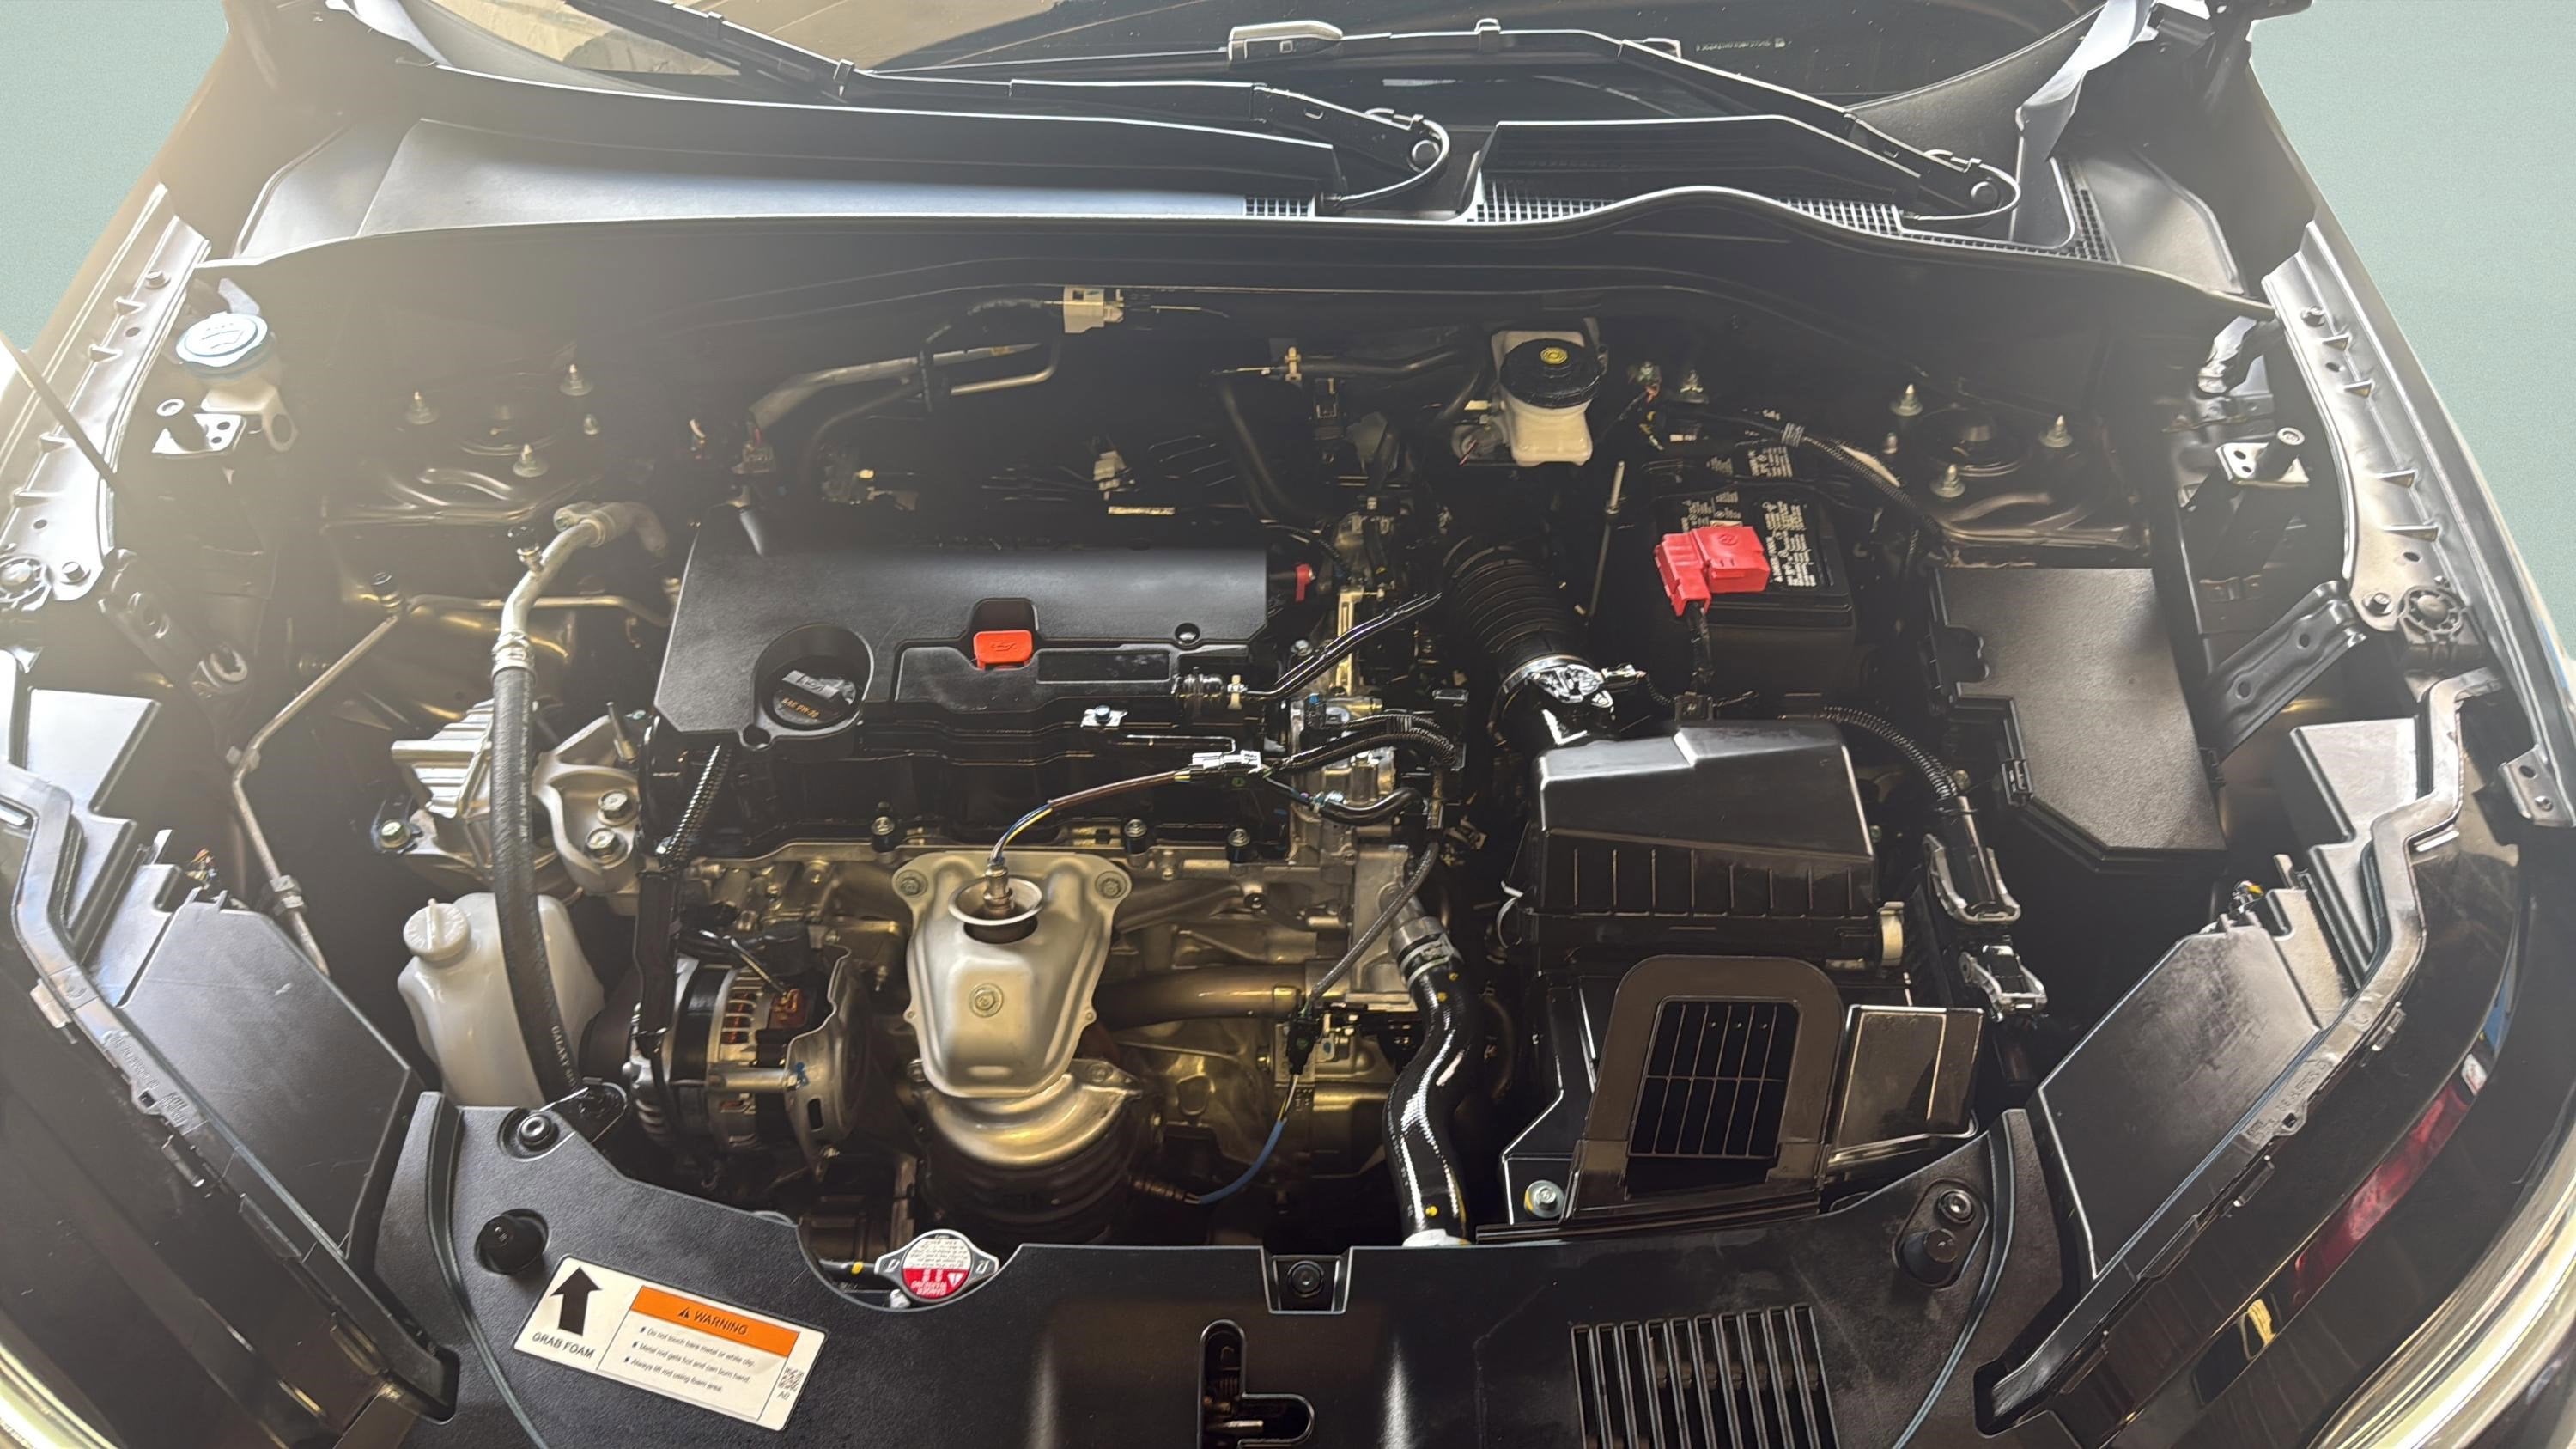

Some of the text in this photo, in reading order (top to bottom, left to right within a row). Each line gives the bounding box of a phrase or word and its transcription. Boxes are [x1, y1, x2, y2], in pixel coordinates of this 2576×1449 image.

[551, 1025, 570, 1066] GALAXY
[694, 1310, 749, 1335] WARNING
[647, 1328, 657, 1336] Do
[532, 1332, 595, 1359] GRAB FOAM
[631, 1359, 653, 1371] Always
[692, 1361, 707, 1369] and
